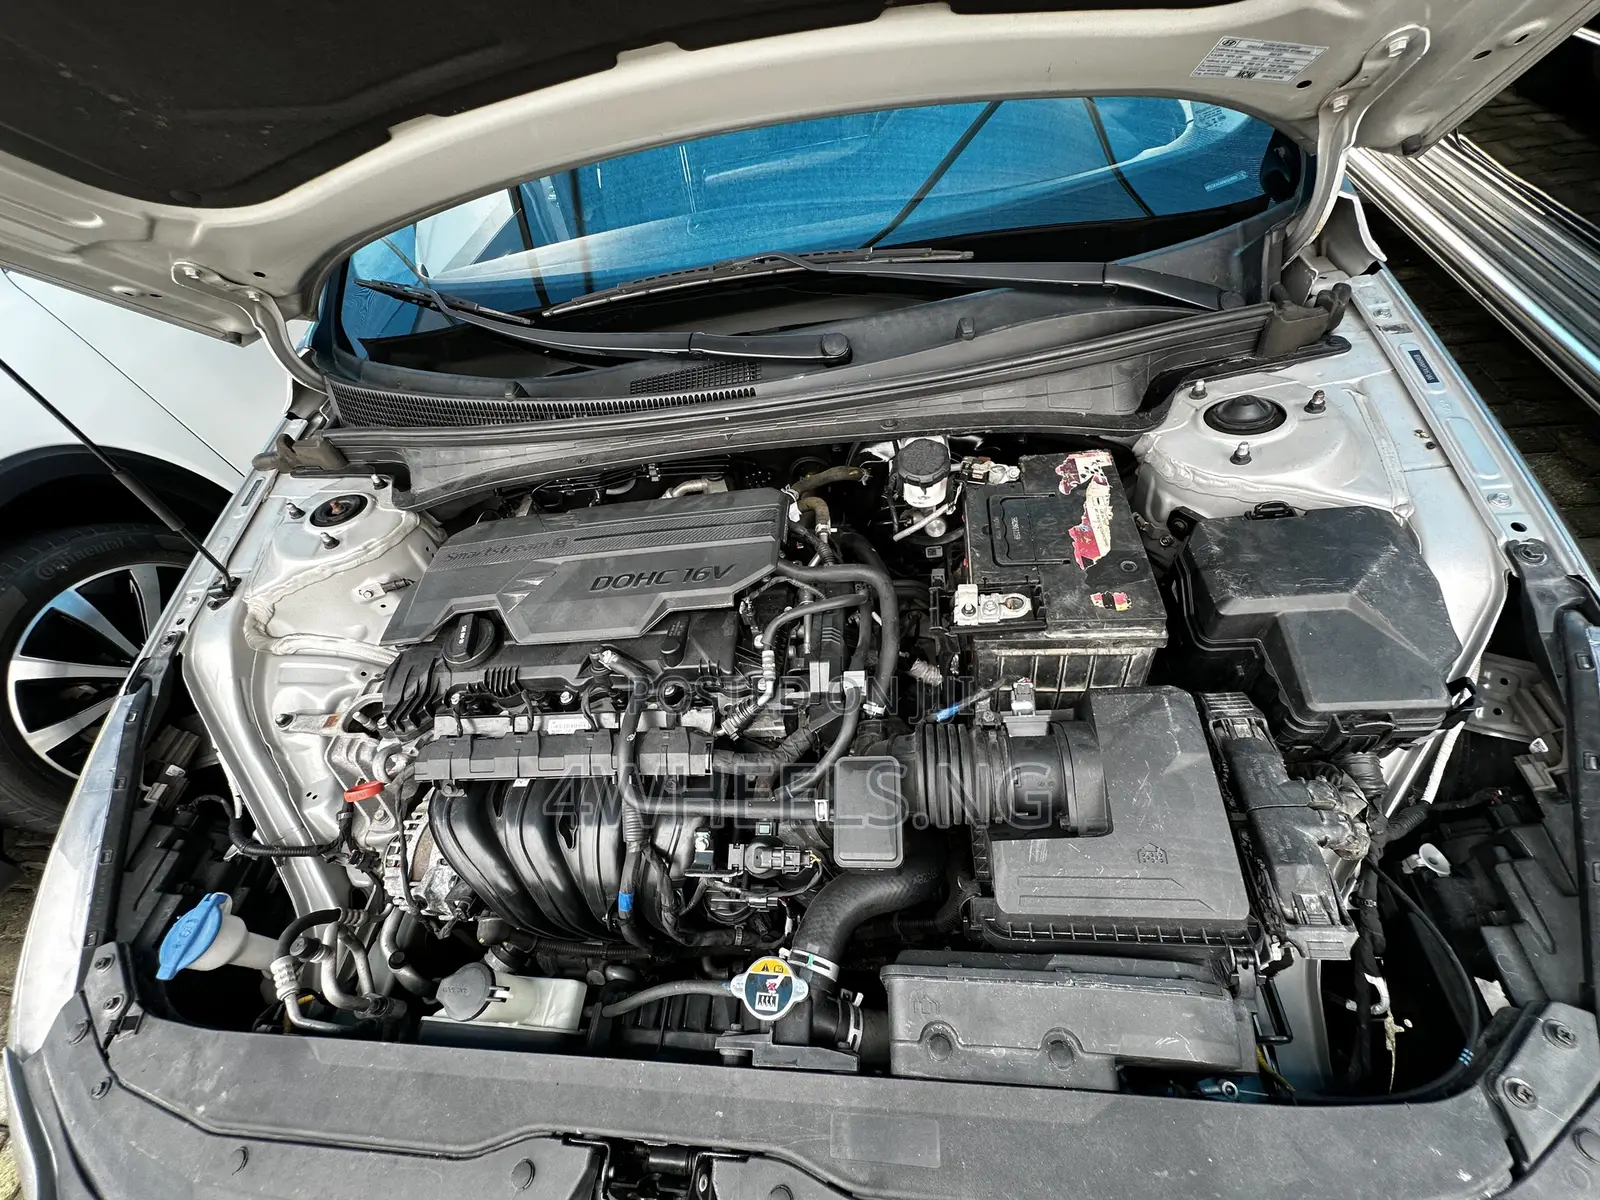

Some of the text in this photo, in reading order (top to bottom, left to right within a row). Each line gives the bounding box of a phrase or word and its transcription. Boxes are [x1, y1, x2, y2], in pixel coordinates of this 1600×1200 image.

[35, 536, 126, 580] Continental
[446, 541, 546, 561] Smartstream
[589, 563, 737, 593] DOHC 16V
